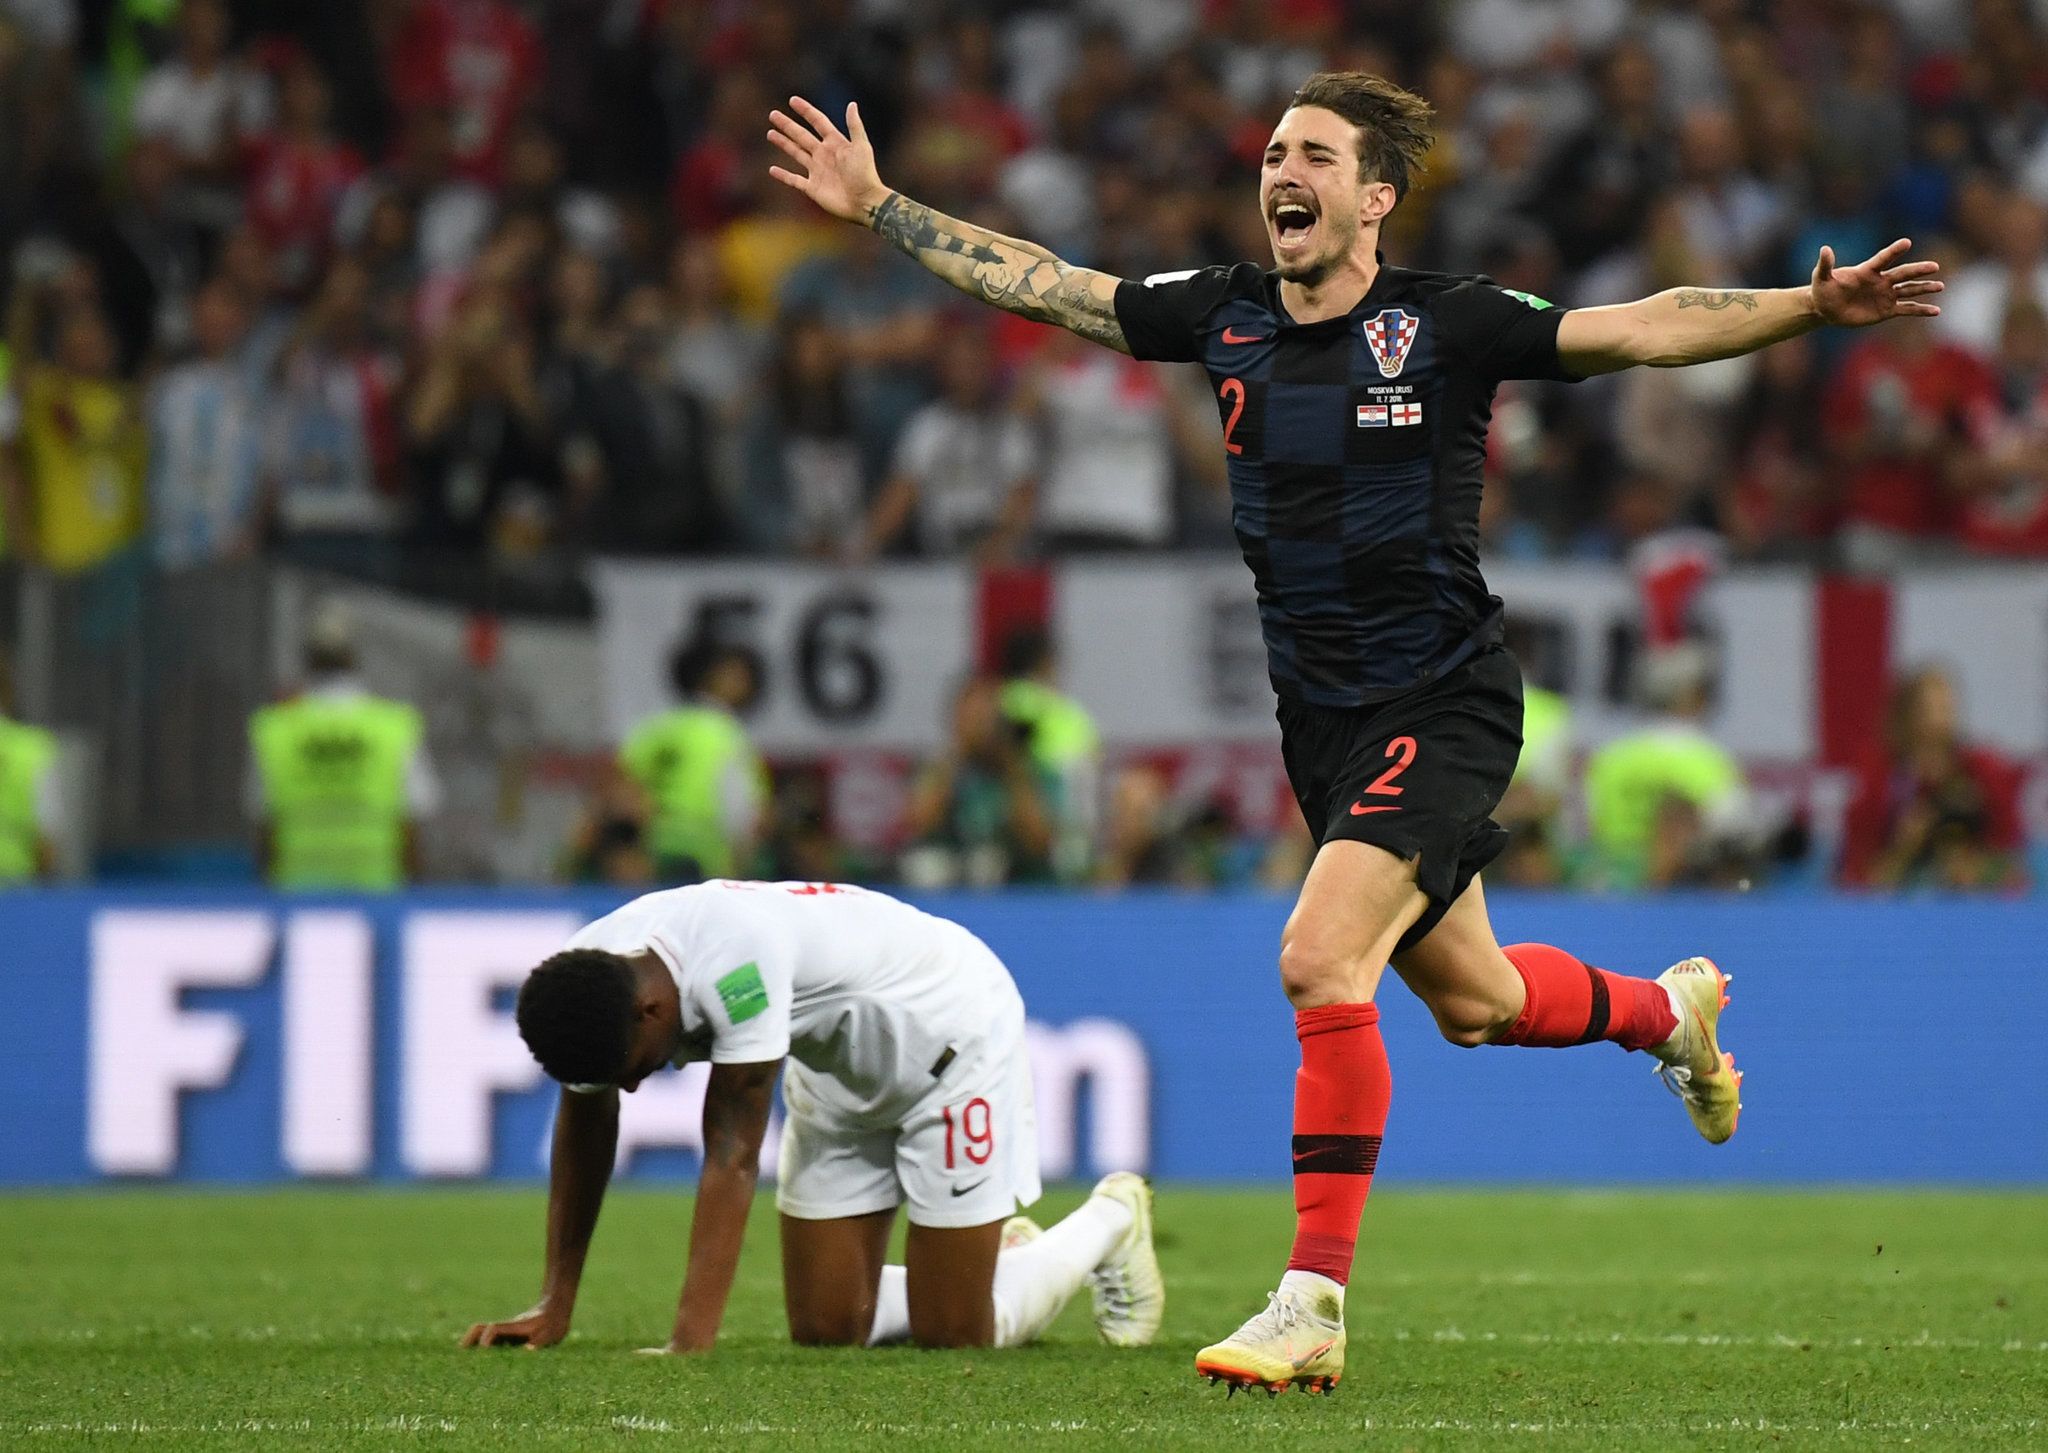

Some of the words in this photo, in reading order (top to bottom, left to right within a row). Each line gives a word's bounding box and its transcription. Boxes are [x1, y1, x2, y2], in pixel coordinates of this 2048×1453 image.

[1220, 377, 1245, 455] 2
[1395, 386, 1413, 394] (RUS)
[1363, 735, 1418, 796] 2
[941, 1097, 993, 1169] 19
